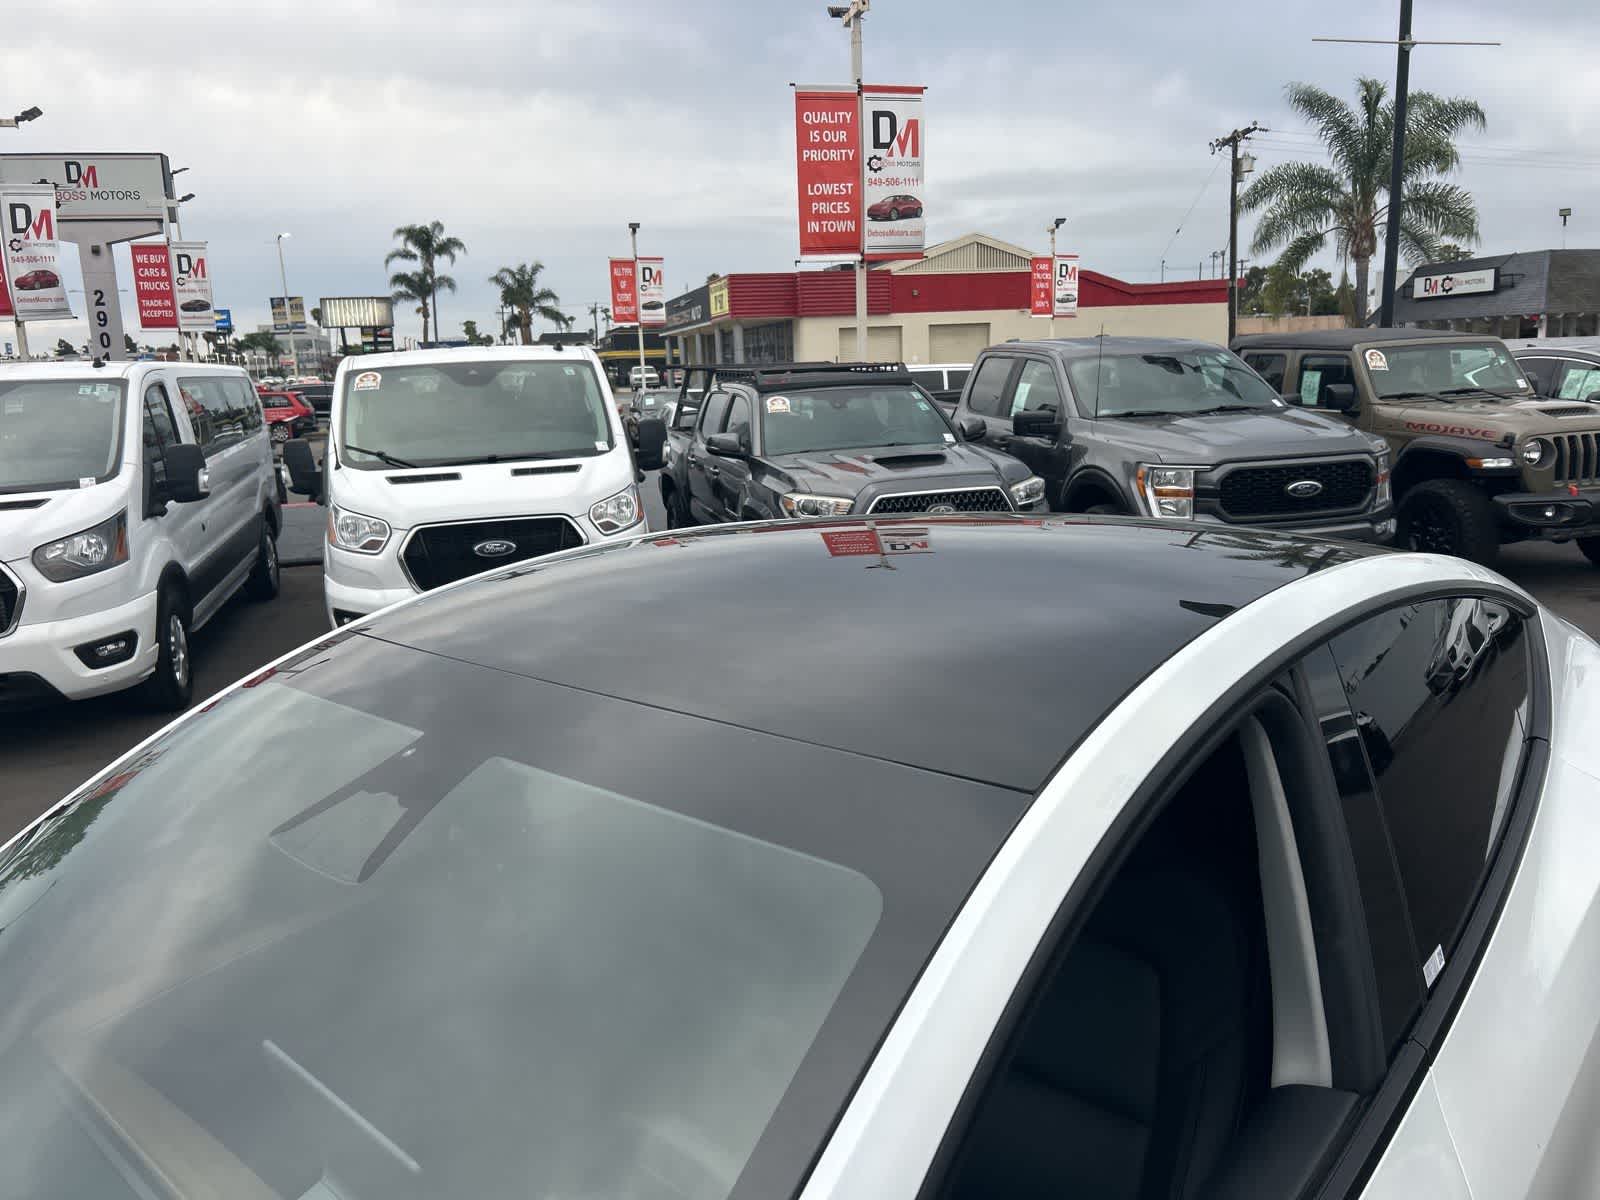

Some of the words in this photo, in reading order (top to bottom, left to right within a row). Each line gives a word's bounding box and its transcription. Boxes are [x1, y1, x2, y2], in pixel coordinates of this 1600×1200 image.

[803, 112, 852, 124] QUALITY
[810, 131, 820, 142] IS
[823, 131, 847, 142] OUR
[872, 111, 919, 158] DM
[803, 149, 854, 161] PRIORITY
[64, 161, 98, 188] DM
[868, 178, 919, 187] 949-506-1111
[808, 183, 853, 195] LOWEST
[90, 191, 141, 201] MOTORS
[812, 202, 850, 214] PRICES
[9, 203, 54, 241] DM
[808, 221, 819, 232] IN
[821, 221, 856, 232] TOWN
[136, 254, 148, 263] WE
[150, 254, 166, 263] BUY
[138, 267, 159, 277] CARS
[160, 267, 168, 277] &
[177, 253, 206, 279] DM
[1060, 264, 1077, 280] DM
[642, 266, 662, 286] DM
[140, 281, 170, 290] TRUCKS
[1424, 278, 1438, 294] DM
[142, 299, 171, 307] TRADE-IN
[142, 310, 173, 318] ACCEPTED
[1405, 422, 1497, 438] MOJAVE
[483, 543, 507, 553] Ford
